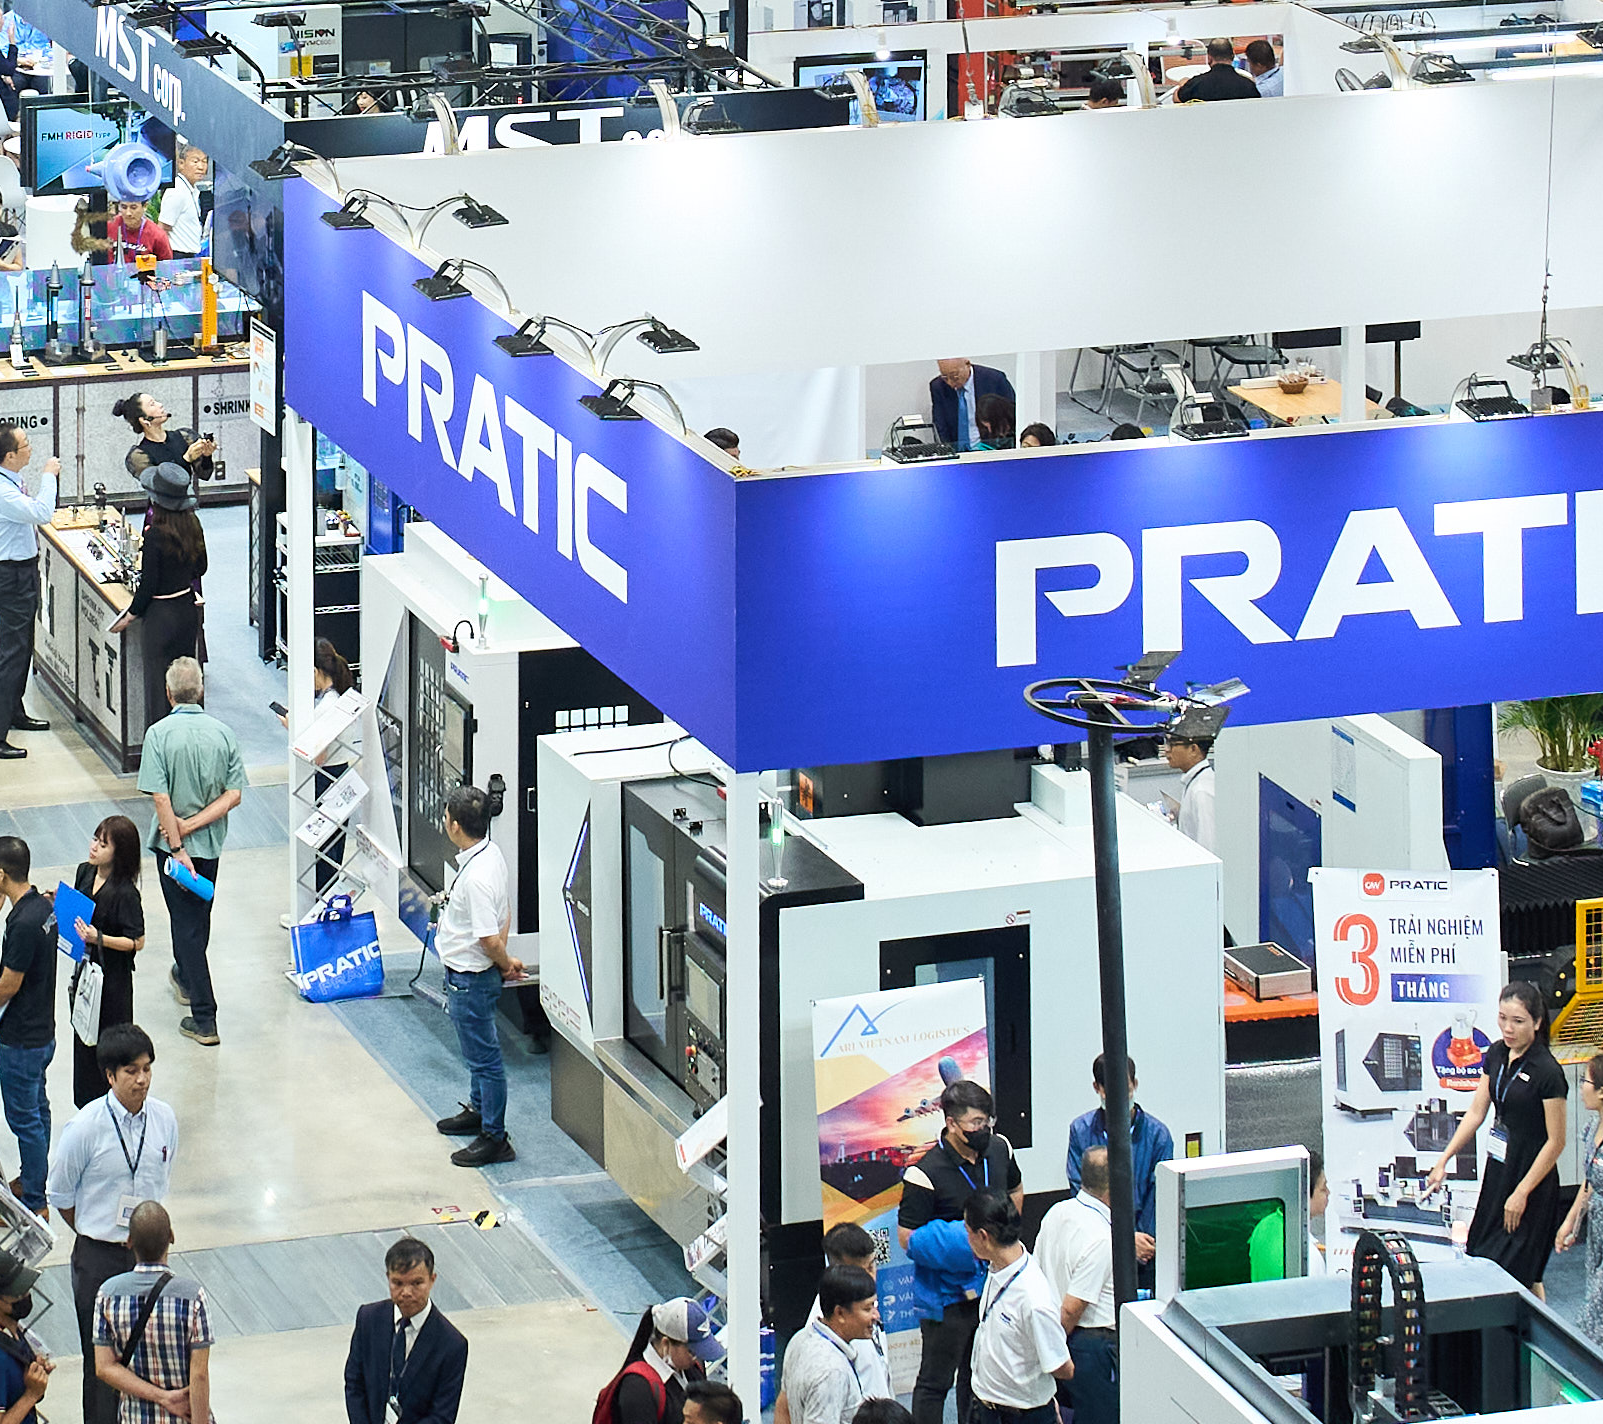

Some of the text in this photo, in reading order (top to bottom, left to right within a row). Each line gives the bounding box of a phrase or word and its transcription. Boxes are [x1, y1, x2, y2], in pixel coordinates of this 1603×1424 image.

[94, 5, 158, 96] MST
[153, 62, 186, 128] corp.
[41, 130, 94, 143] FMH RIGID
[358, 287, 630, 607] PRATIC
[1389, 879, 1449, 892] PRATIC
[1389, 909, 1484, 941] TRẢI NGHIỆM
[1333, 912, 1380, 1007] 3
[1390, 939, 1457, 965] MIỄN PHÍ
[1396, 976, 1450, 1000] THÁNG
